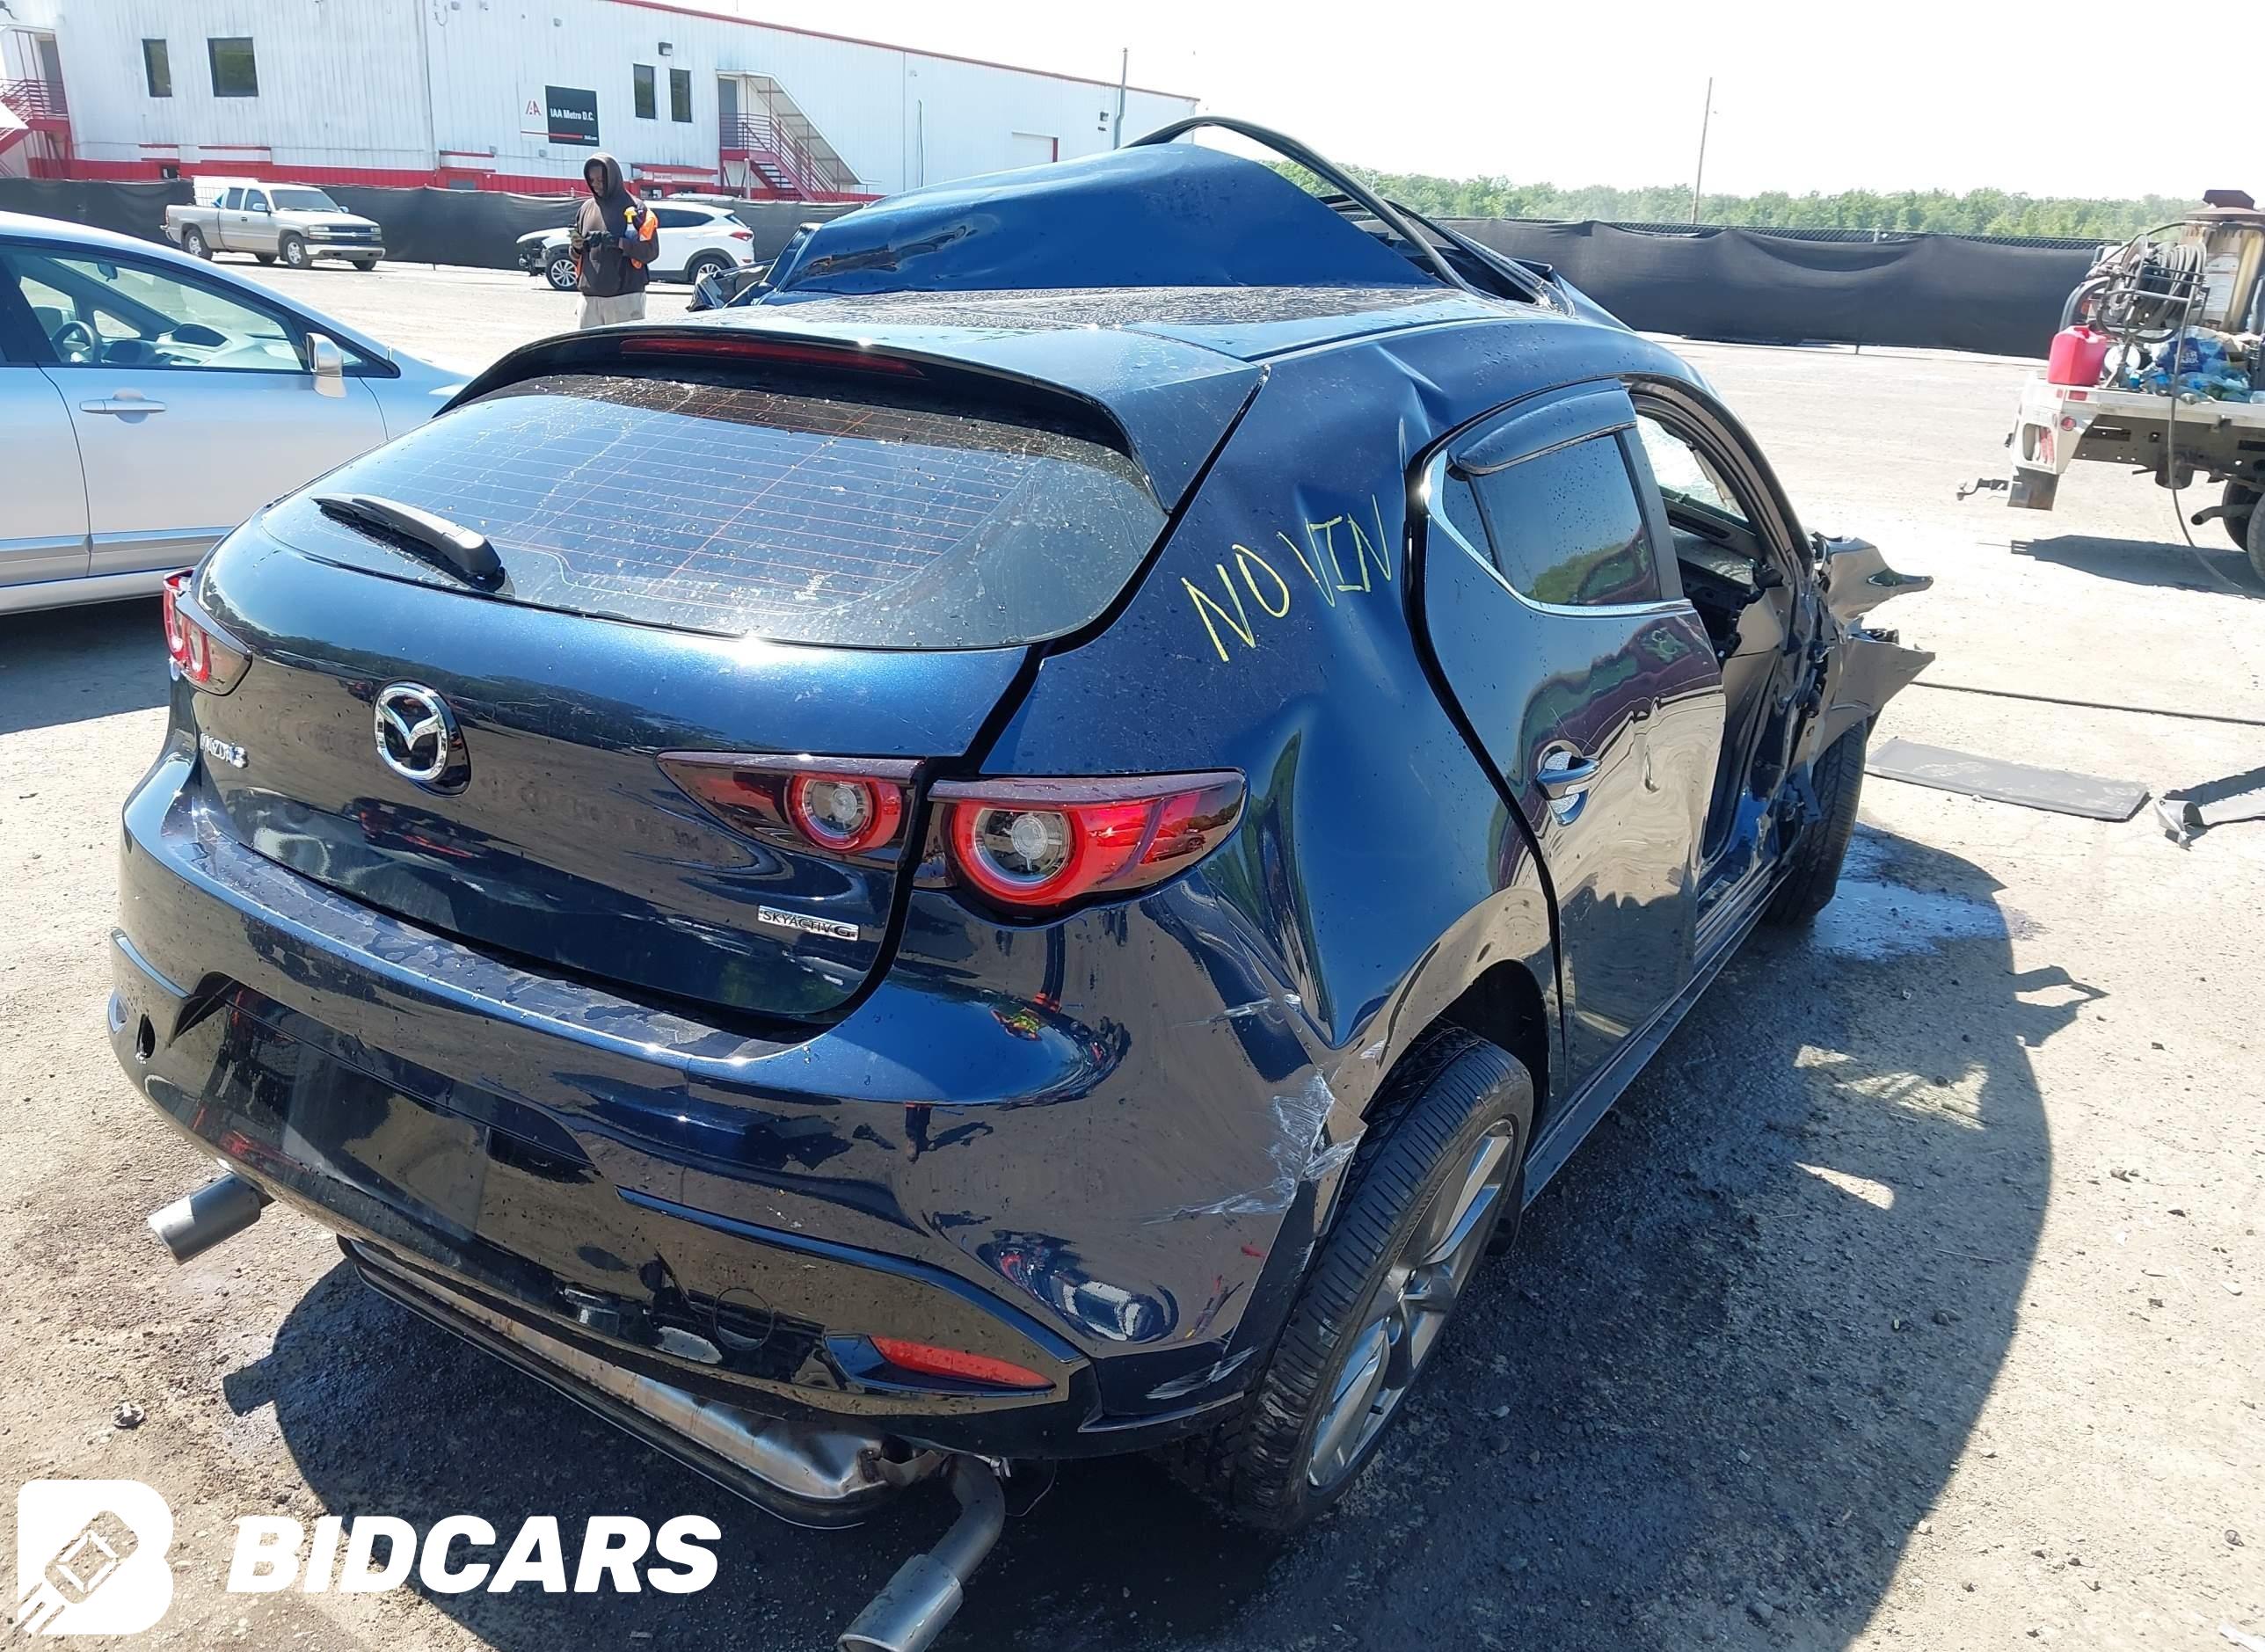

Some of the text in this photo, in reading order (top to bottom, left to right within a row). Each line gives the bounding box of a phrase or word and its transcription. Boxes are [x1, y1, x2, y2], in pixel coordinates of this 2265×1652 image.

[550, 107, 595, 121] IAA Metro D.C.
[1181, 493, 1391, 662] NO VIN
